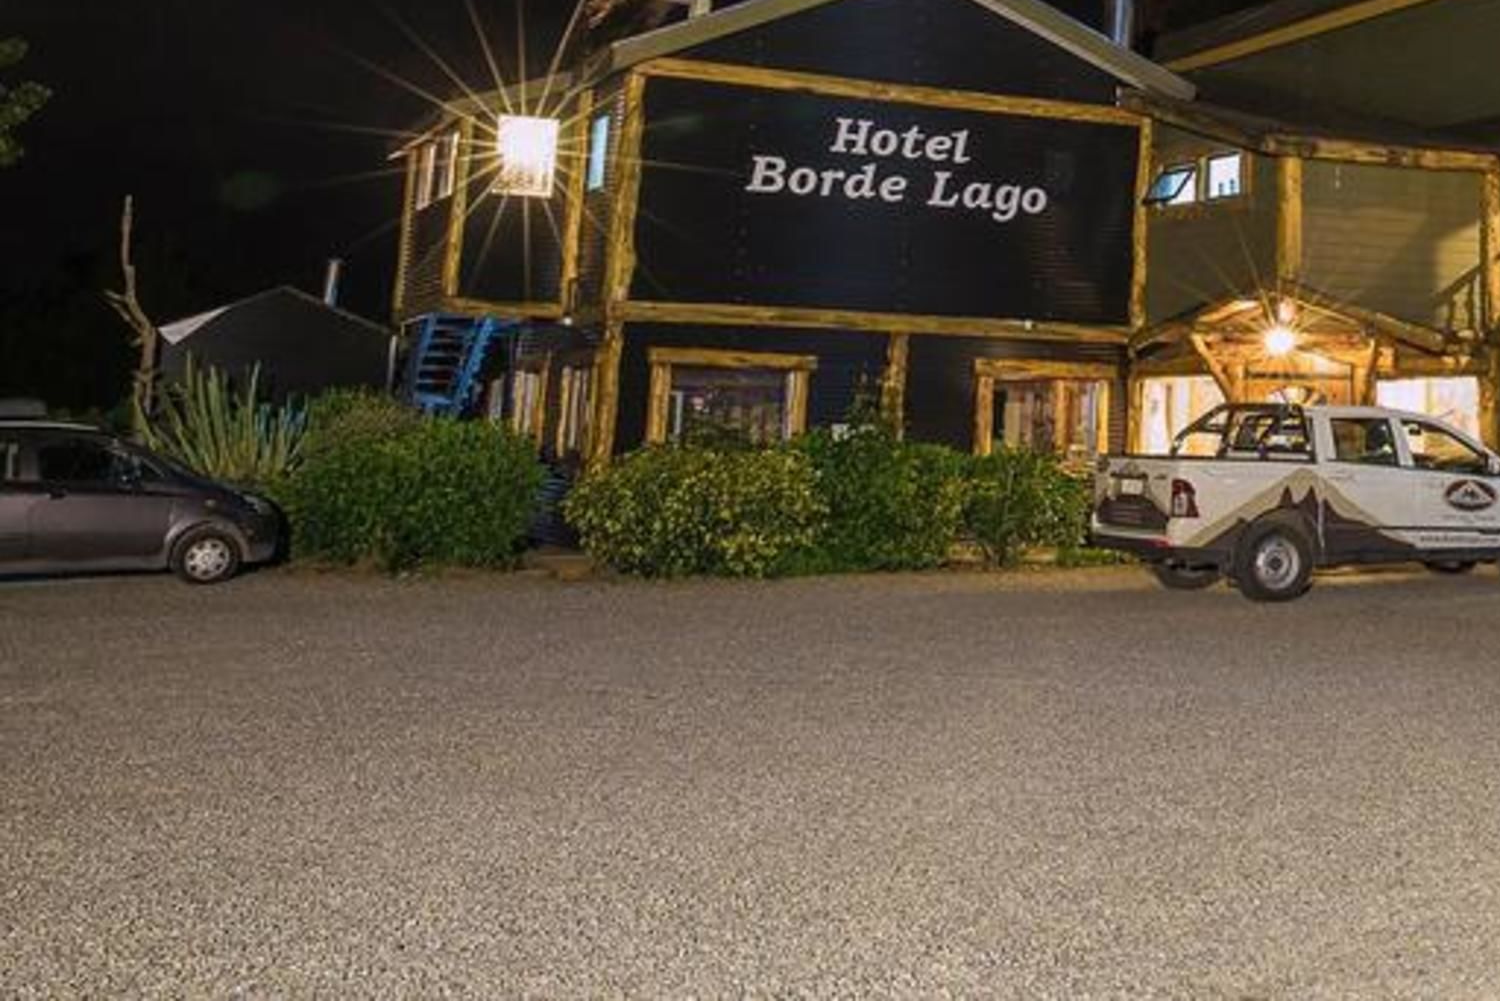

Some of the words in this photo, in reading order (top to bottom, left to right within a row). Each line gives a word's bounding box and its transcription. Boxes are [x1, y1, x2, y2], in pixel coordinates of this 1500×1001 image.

[829, 117, 971, 164] Hotel
[745, 155, 907, 202] Borde
[926, 171, 1048, 222] Lago
